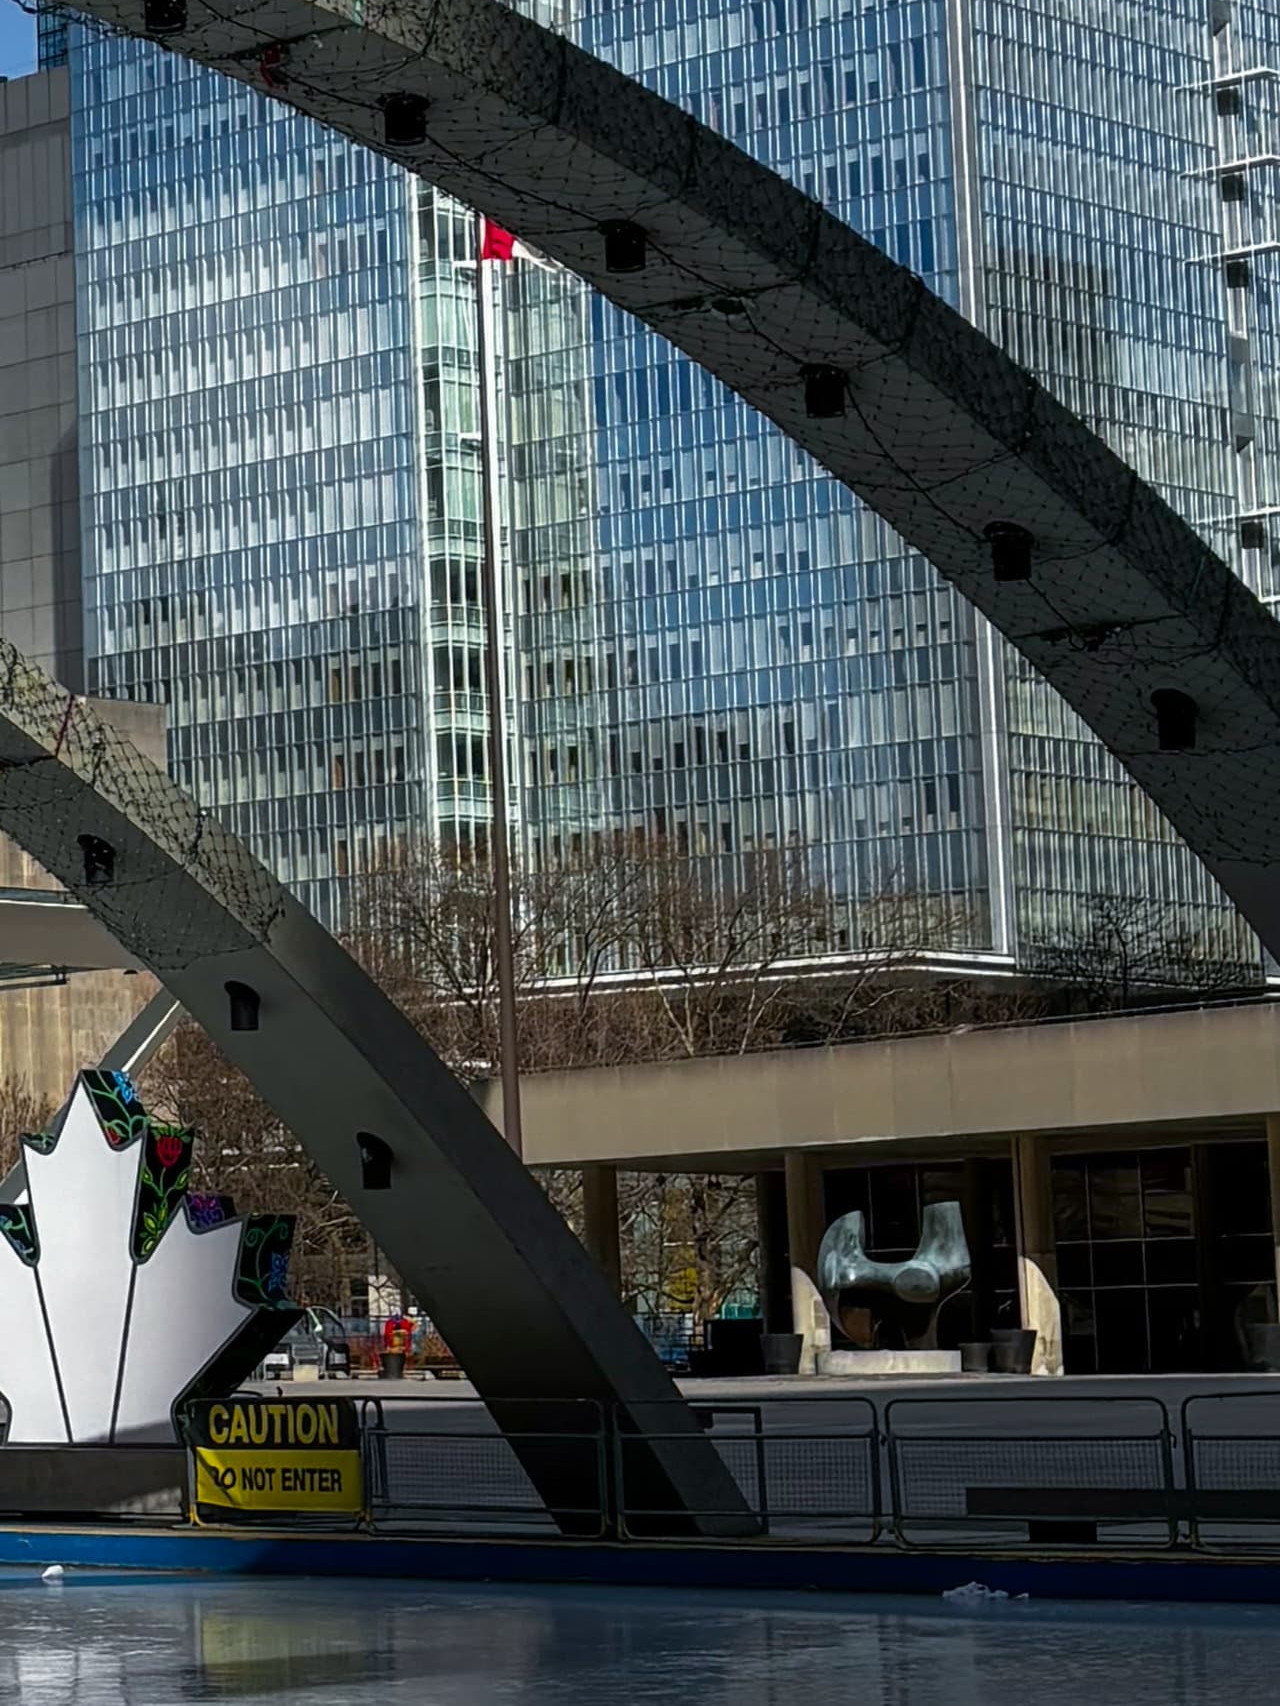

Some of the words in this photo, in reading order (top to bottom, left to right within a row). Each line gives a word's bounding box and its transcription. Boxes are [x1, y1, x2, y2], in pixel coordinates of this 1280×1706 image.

[208, 1403, 340, 1445] CAUTION
[242, 1468, 275, 1491] NOT
[282, 1468, 342, 1492] ENTER
